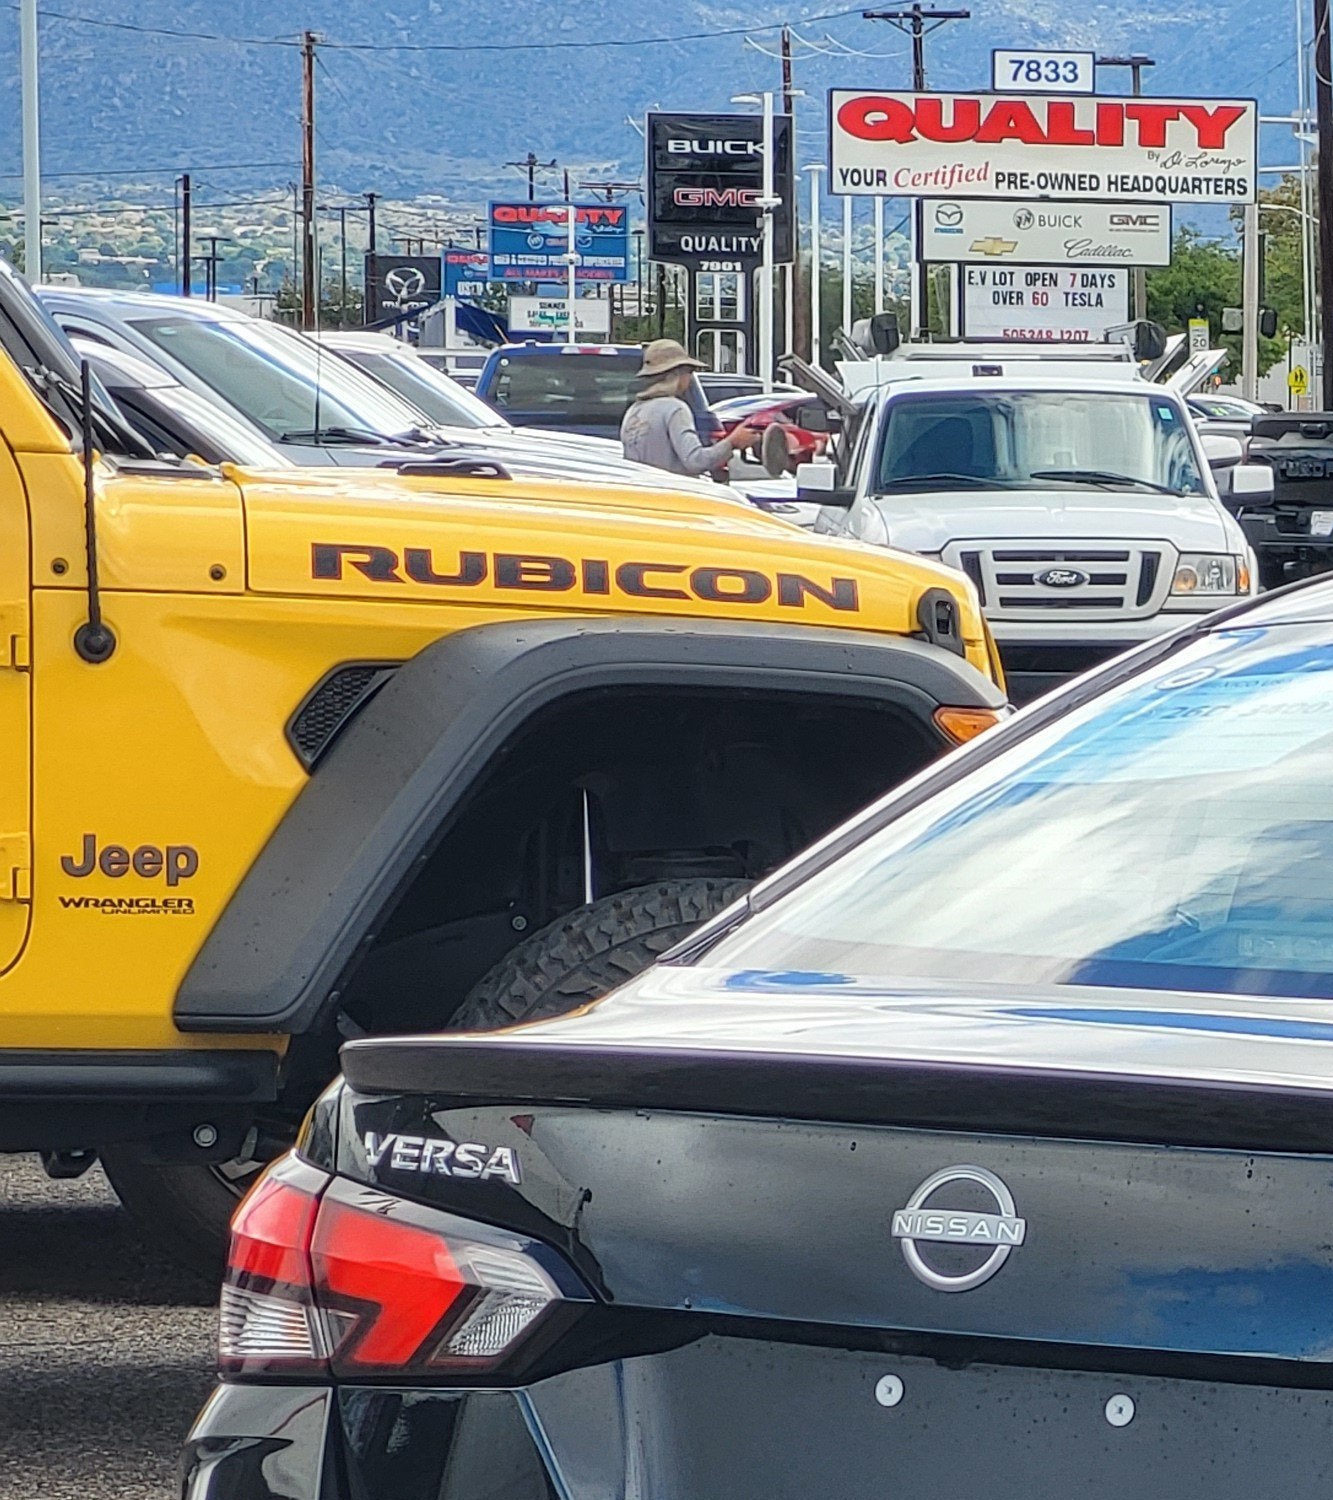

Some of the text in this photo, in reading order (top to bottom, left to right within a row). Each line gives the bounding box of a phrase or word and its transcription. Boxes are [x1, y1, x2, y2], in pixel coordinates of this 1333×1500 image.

[1009, 60, 1079, 83] 7833
[837, 96, 1247, 149] QUALITY
[667, 139, 764, 155] BUICK
[1148, 151, 1160, 162] By
[839, 161, 1248, 195] YOUR Certified PRE-OWNED HEADQUARTERS
[673, 187, 766, 208] GMC
[1038, 215, 1083, 229] BUICK
[1109, 214, 1160, 227] GMC
[680, 235, 760, 252] QUALITY
[1063, 238, 1133, 258] Cadillac
[968, 271, 1116, 289] E.V LOT OPEN 7 DAYS
[992, 291, 1104, 308] OVER 60 TESLA
[1193, 338, 1207, 347] 20
[312, 543, 859, 611] RUBICON
[1046, 570, 1077, 585] Ford
[61, 834, 198, 886] Jeep
[58, 897, 193, 909] WRANGLER
[364, 1131, 522, 1185] VERSA
[894, 1215, 1021, 1241] NISSAN
